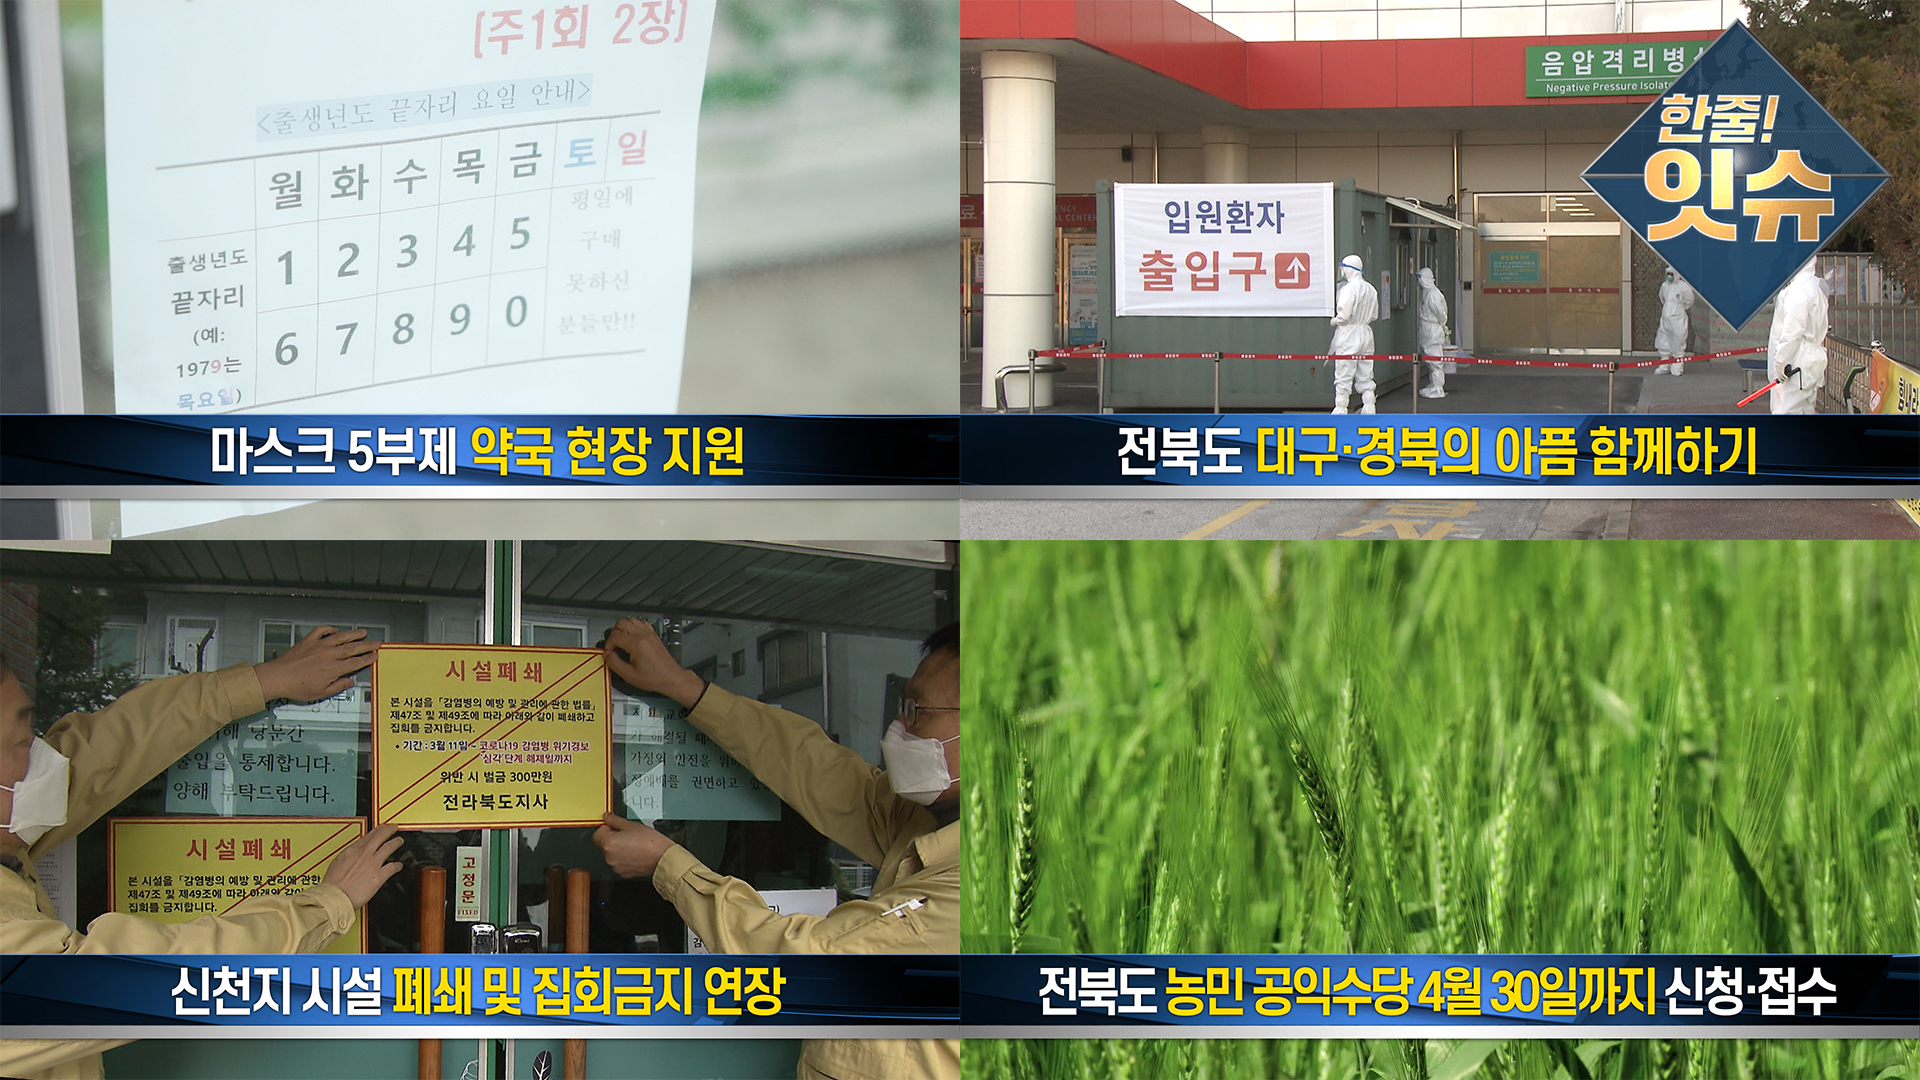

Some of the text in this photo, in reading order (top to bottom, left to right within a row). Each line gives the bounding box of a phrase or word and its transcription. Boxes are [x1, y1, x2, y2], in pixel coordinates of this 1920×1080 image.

[1542, 47, 1703, 76] 음압격리병
[1546, 83, 1590, 94] Negative
[1593, 82, 1638, 91] Pressure
[258, 78, 590, 135] <출생년도 끝자리 요일 안내>
[269, 130, 647, 210] 월 화 수 목 금 토 일
[572, 185, 633, 211] 평일에
[1164, 200, 1285, 235] 입원환자
[579, 228, 621, 250] 구매
[168, 249, 248, 274] 출생년도
[278, 216, 530, 285] 1 2 3 4 5
[567, 269, 629, 294] 못하신
[1138, 250, 1267, 292] 출입구
[171, 285, 244, 315] 끝자리
[275, 295, 527, 366] 6 7 8 9 0
[558, 311, 636, 335] 분들만!!
[193, 327, 225, 346] (예:
[176, 357, 242, 378] 1979는
[177, 387, 242, 411] 목요일)
[445, 660, 543, 683] 시설폐쇄
[390, 697, 400, 708] 본
[404, 697, 433, 709] 시설을
[485, 698, 505, 709] 예방
[508, 698, 517, 709] 및
[520, 698, 547, 710] 관리에
[552, 699, 570, 710] 관한
[390, 710, 595, 723] 제47조 및 제49조에 따라 아래와 같이 폐쇄하고
[390, 724, 475, 734] 집회를 금지합니다.
[430, 740, 446, 751] 3월
[448, 740, 469, 751] 11일
[479, 740, 519, 752] 코로나19
[522, 740, 550, 752] 감염병
[552, 740, 590, 752] 위기경보
[238, 753, 335, 773] 통제합니다.
[526, 754, 573, 765] 해제일까지
[676, 752, 711, 768] 안전을
[440, 771, 553, 784] 위반 시 벌금 300만원
[691, 775, 739, 790] 권면하고
[174, 781, 335, 804] 양해 부탁드립니다.
[443, 794, 549, 811] 전라북도지사
[186, 838, 292, 861] 시설폐쇄
[128, 876, 138, 887] 본
[142, 876, 173, 887] 시설을
[228, 875, 249, 886] 예방
[253, 875, 263, 886] 및
[267, 875, 297, 886] 관리에
[301, 875, 321, 886] 관한
[462, 857, 476, 904] 고정문
[128, 889, 161, 899] 제47조
[165, 889, 175, 899] 및
[178, 889, 222, 899] 제49조에
[226, 888, 247, 899] 따라
[128, 902, 218, 913] 집회를 금지합니다.
